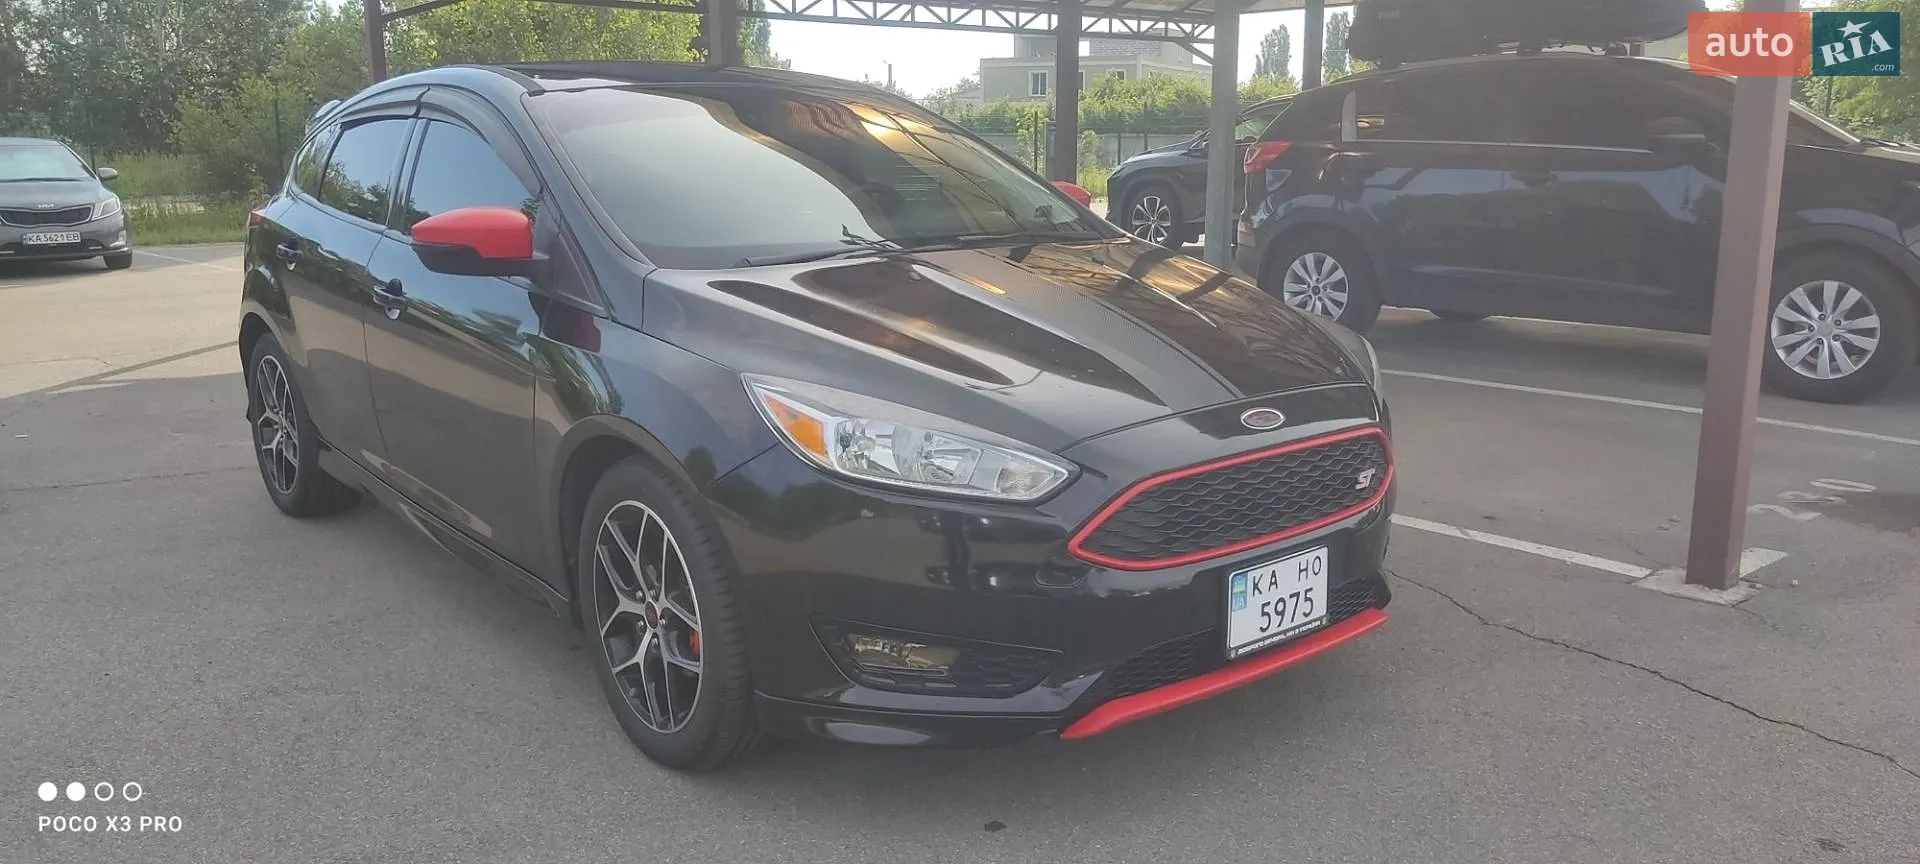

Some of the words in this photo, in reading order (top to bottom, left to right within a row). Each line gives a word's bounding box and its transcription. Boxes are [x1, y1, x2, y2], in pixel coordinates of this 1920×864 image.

[1355, 468, 1375, 490] ST
[1252, 569, 1278, 597] KA
[1298, 555, 1322, 582] HO
[1259, 587, 1314, 633] 5975
